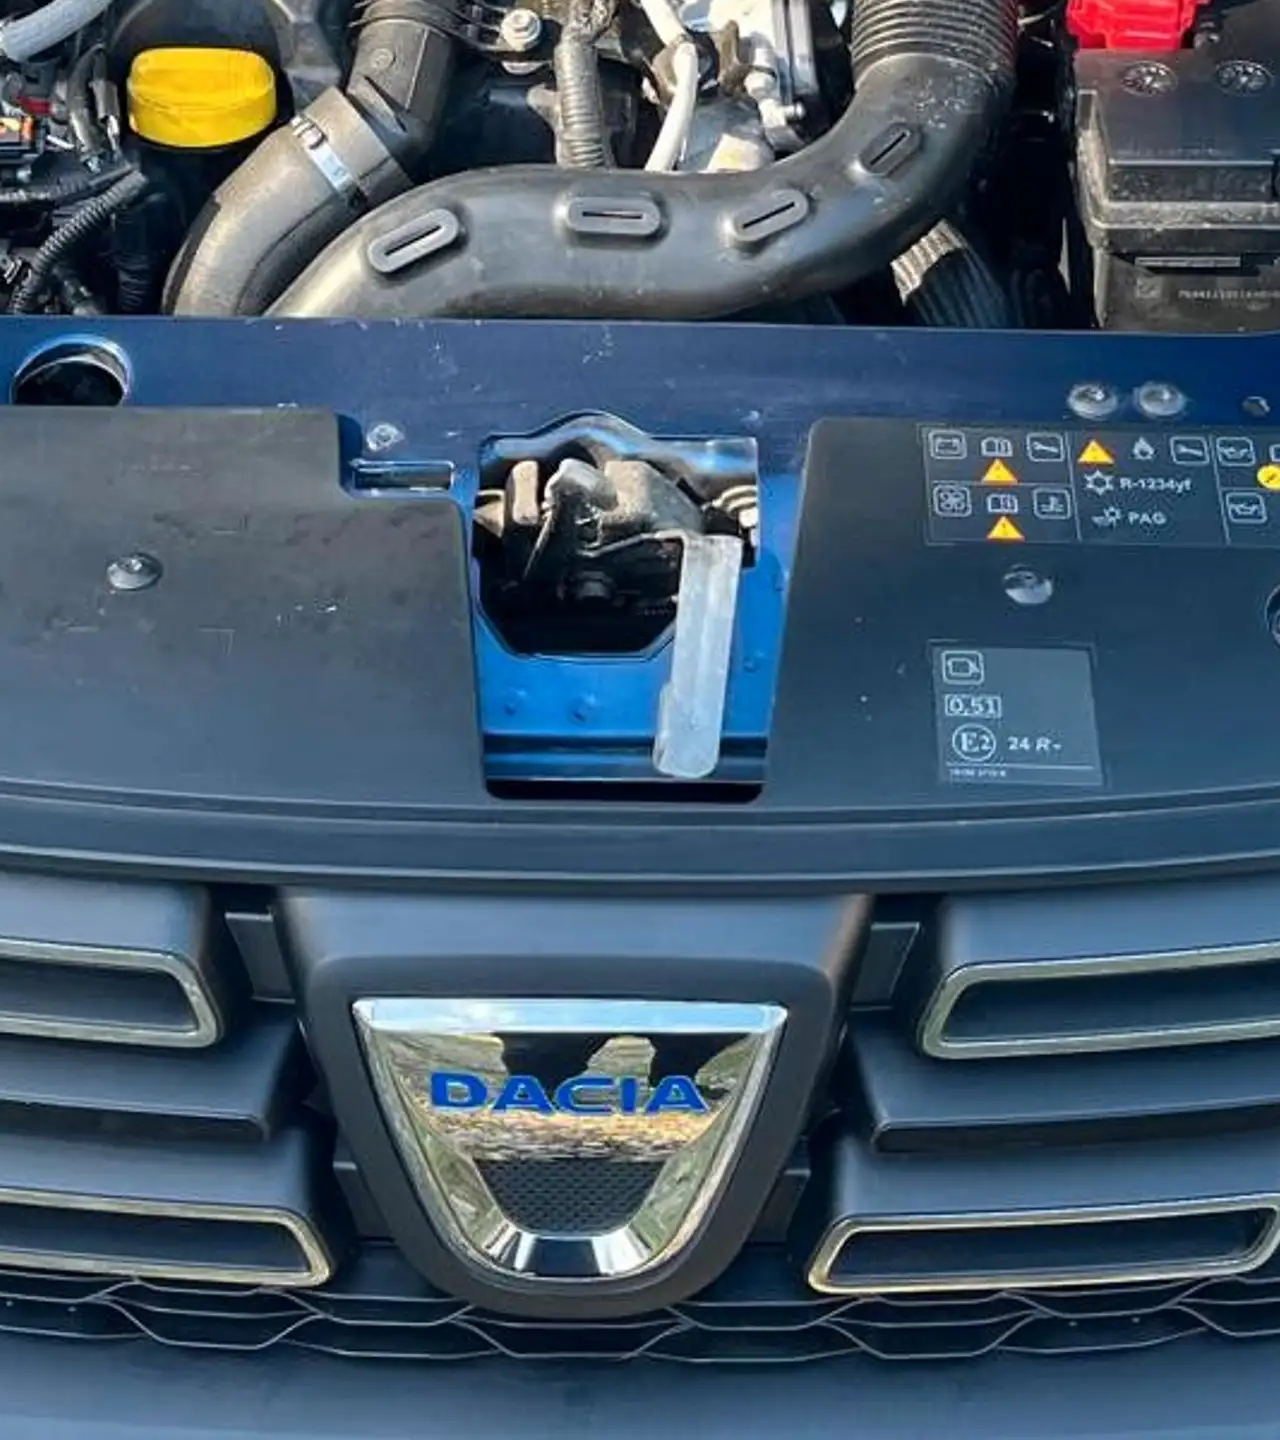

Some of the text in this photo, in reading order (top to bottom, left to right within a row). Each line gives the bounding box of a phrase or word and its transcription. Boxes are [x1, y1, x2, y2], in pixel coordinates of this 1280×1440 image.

[1119, 477, 1192, 494] R-1234yf
[1128, 511, 1167, 525] PAG
[1007, 737, 1030, 751] 24
[429, 1071, 710, 1116] DACIA
